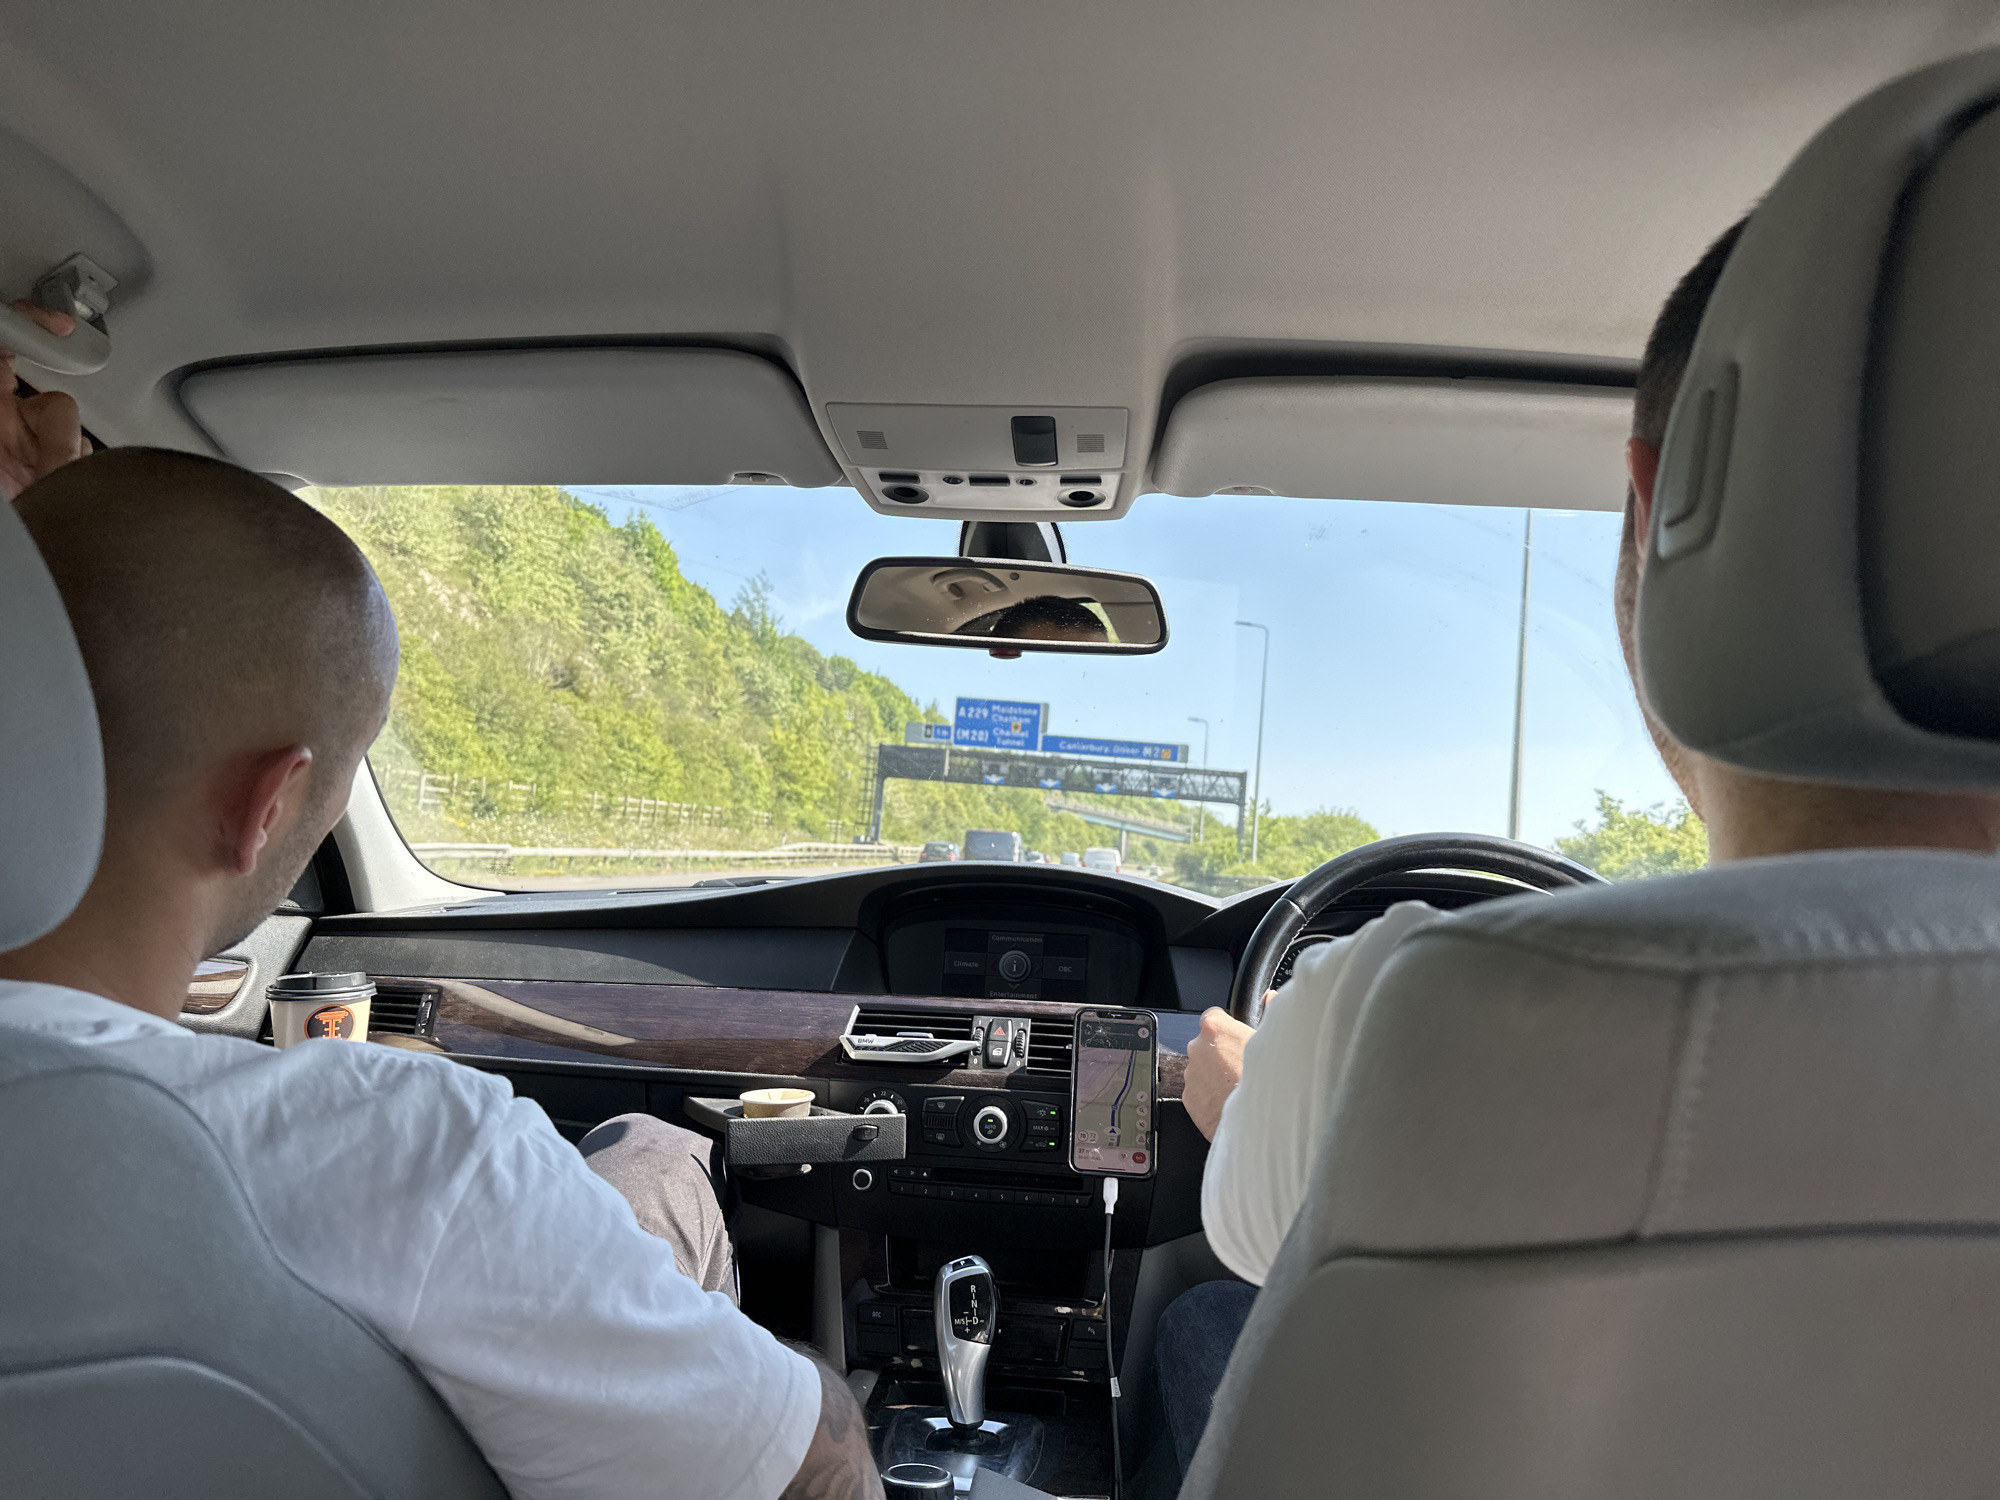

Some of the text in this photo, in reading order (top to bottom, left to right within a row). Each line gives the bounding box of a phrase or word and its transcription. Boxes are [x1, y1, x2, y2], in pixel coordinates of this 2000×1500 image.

[991, 704, 1038, 716] Maidstone
[991, 934, 1043, 943] Communication
[953, 960, 980, 968] Climate
[1058, 965, 1072, 973] OBC
[989, 990, 1038, 999] Entertainment
